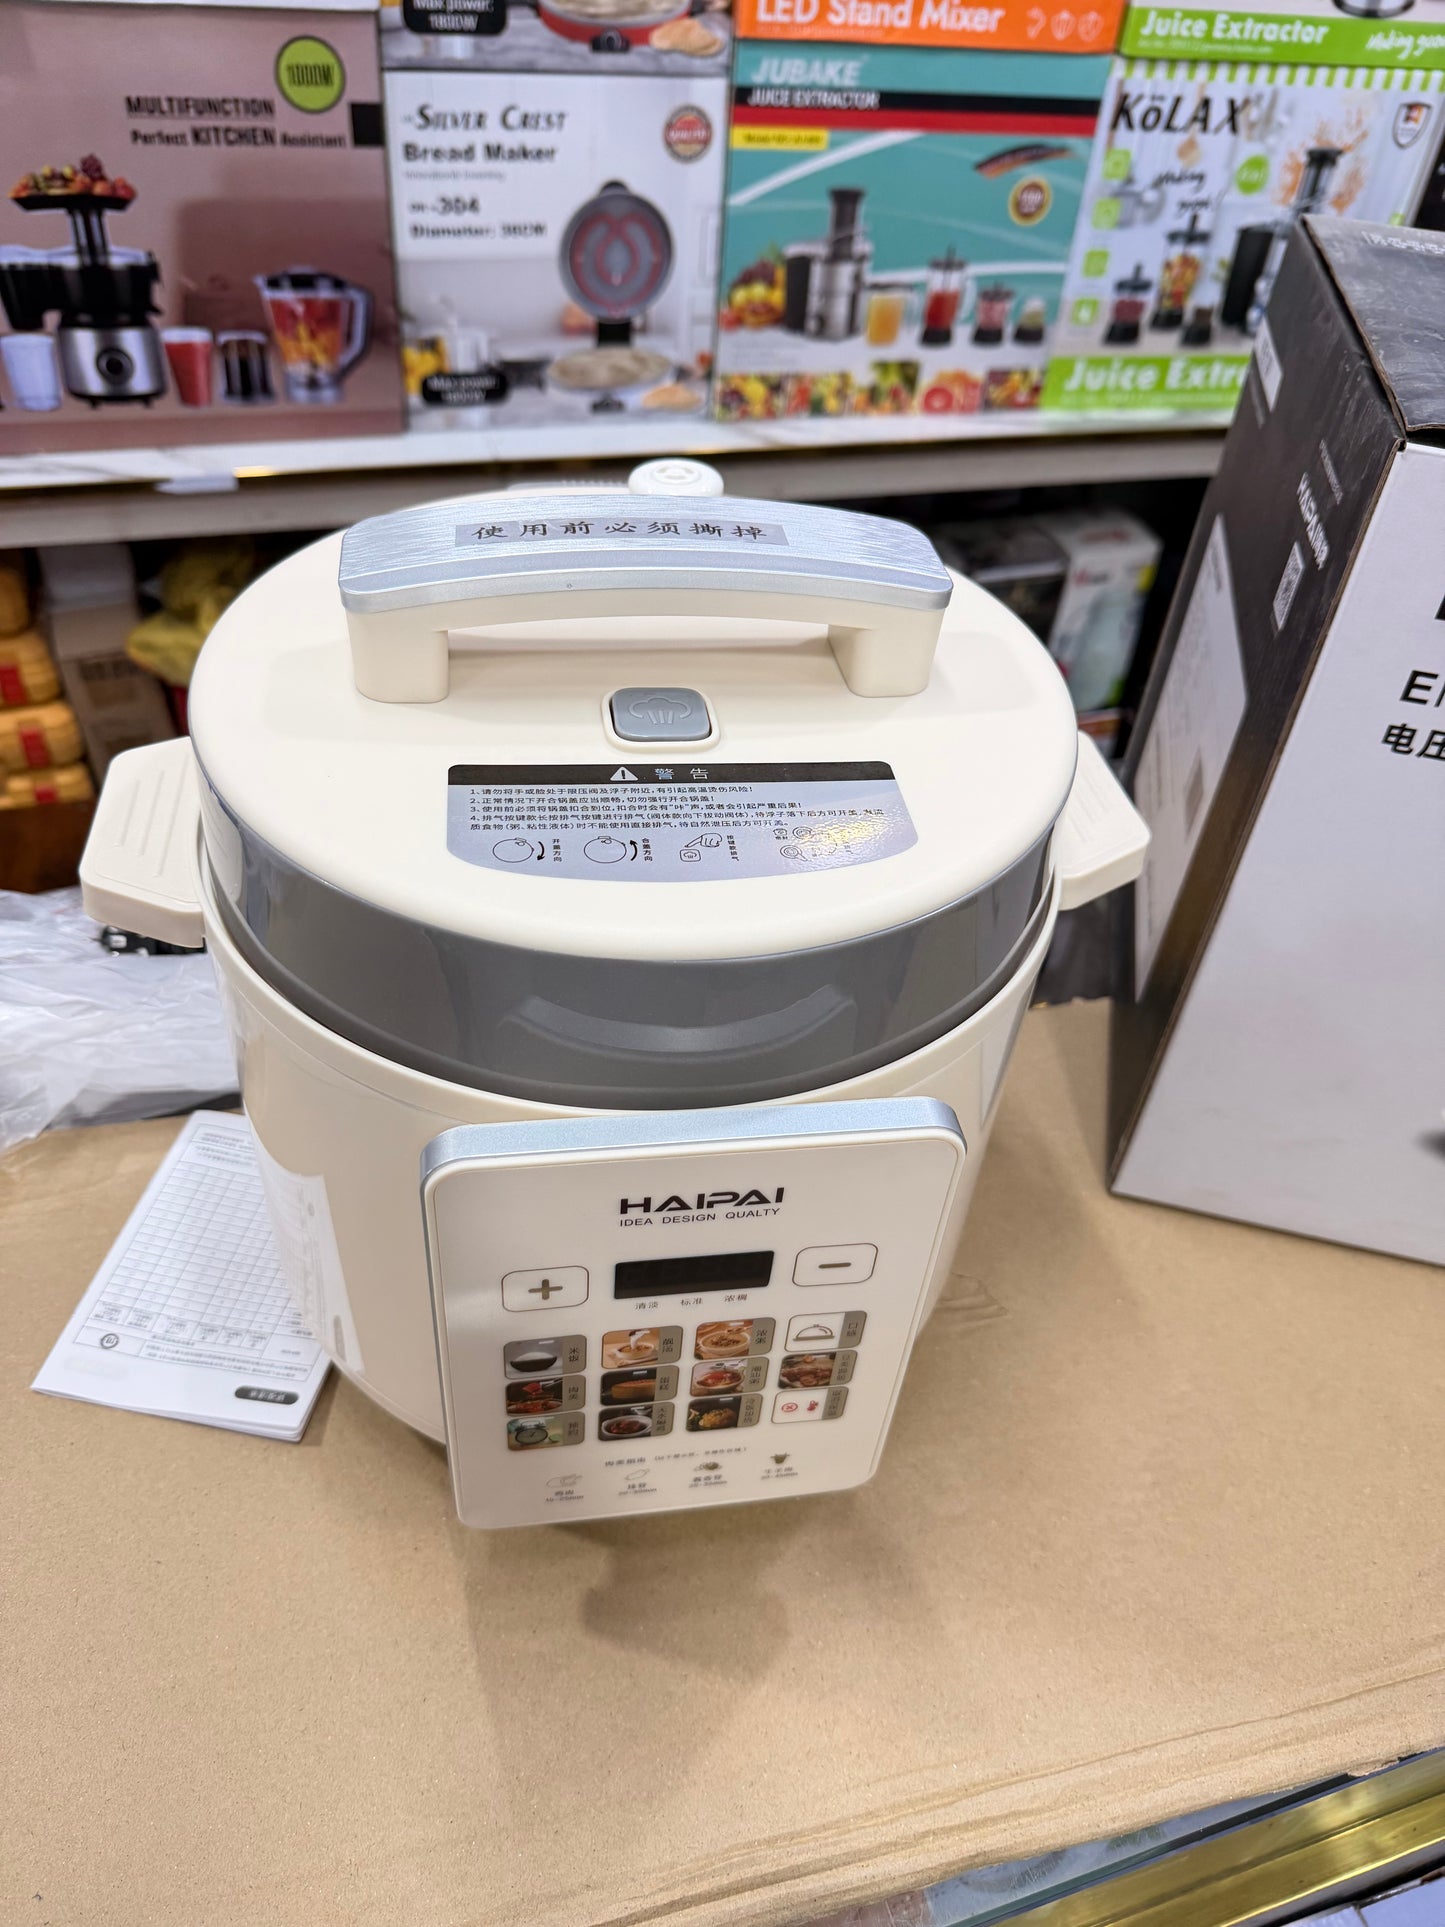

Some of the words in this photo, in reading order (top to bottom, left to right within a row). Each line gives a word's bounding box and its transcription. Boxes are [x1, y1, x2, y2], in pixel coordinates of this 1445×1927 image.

[756, 0, 820, 23] LED
[827, 0, 914, 28] Stand
[919, 0, 1005, 32] Mixer
[1140, 11, 1207, 38] Juice
[1212, 14, 1329, 44] Extractor
[751, 57, 861, 87] JUBAKE
[126, 96, 275, 117] MULTIFUNCTION
[131, 129, 187, 145] Perfect
[191, 126, 276, 147] KITCHEN
[403, 142, 475, 163] Bread
[484, 142, 558, 163] Maker
[1064, 356, 1160, 392] Juice
[472, 520, 769, 541] 使用前必须撕掉
[1400, 669, 1445, 708] E
[620, 1187, 785, 1215] HAIPAI
[620, 1218, 654, 1227] IDEA
[662, 1213, 716, 1224] DESIGN
[725, 1208, 781, 1219] QUALTY
